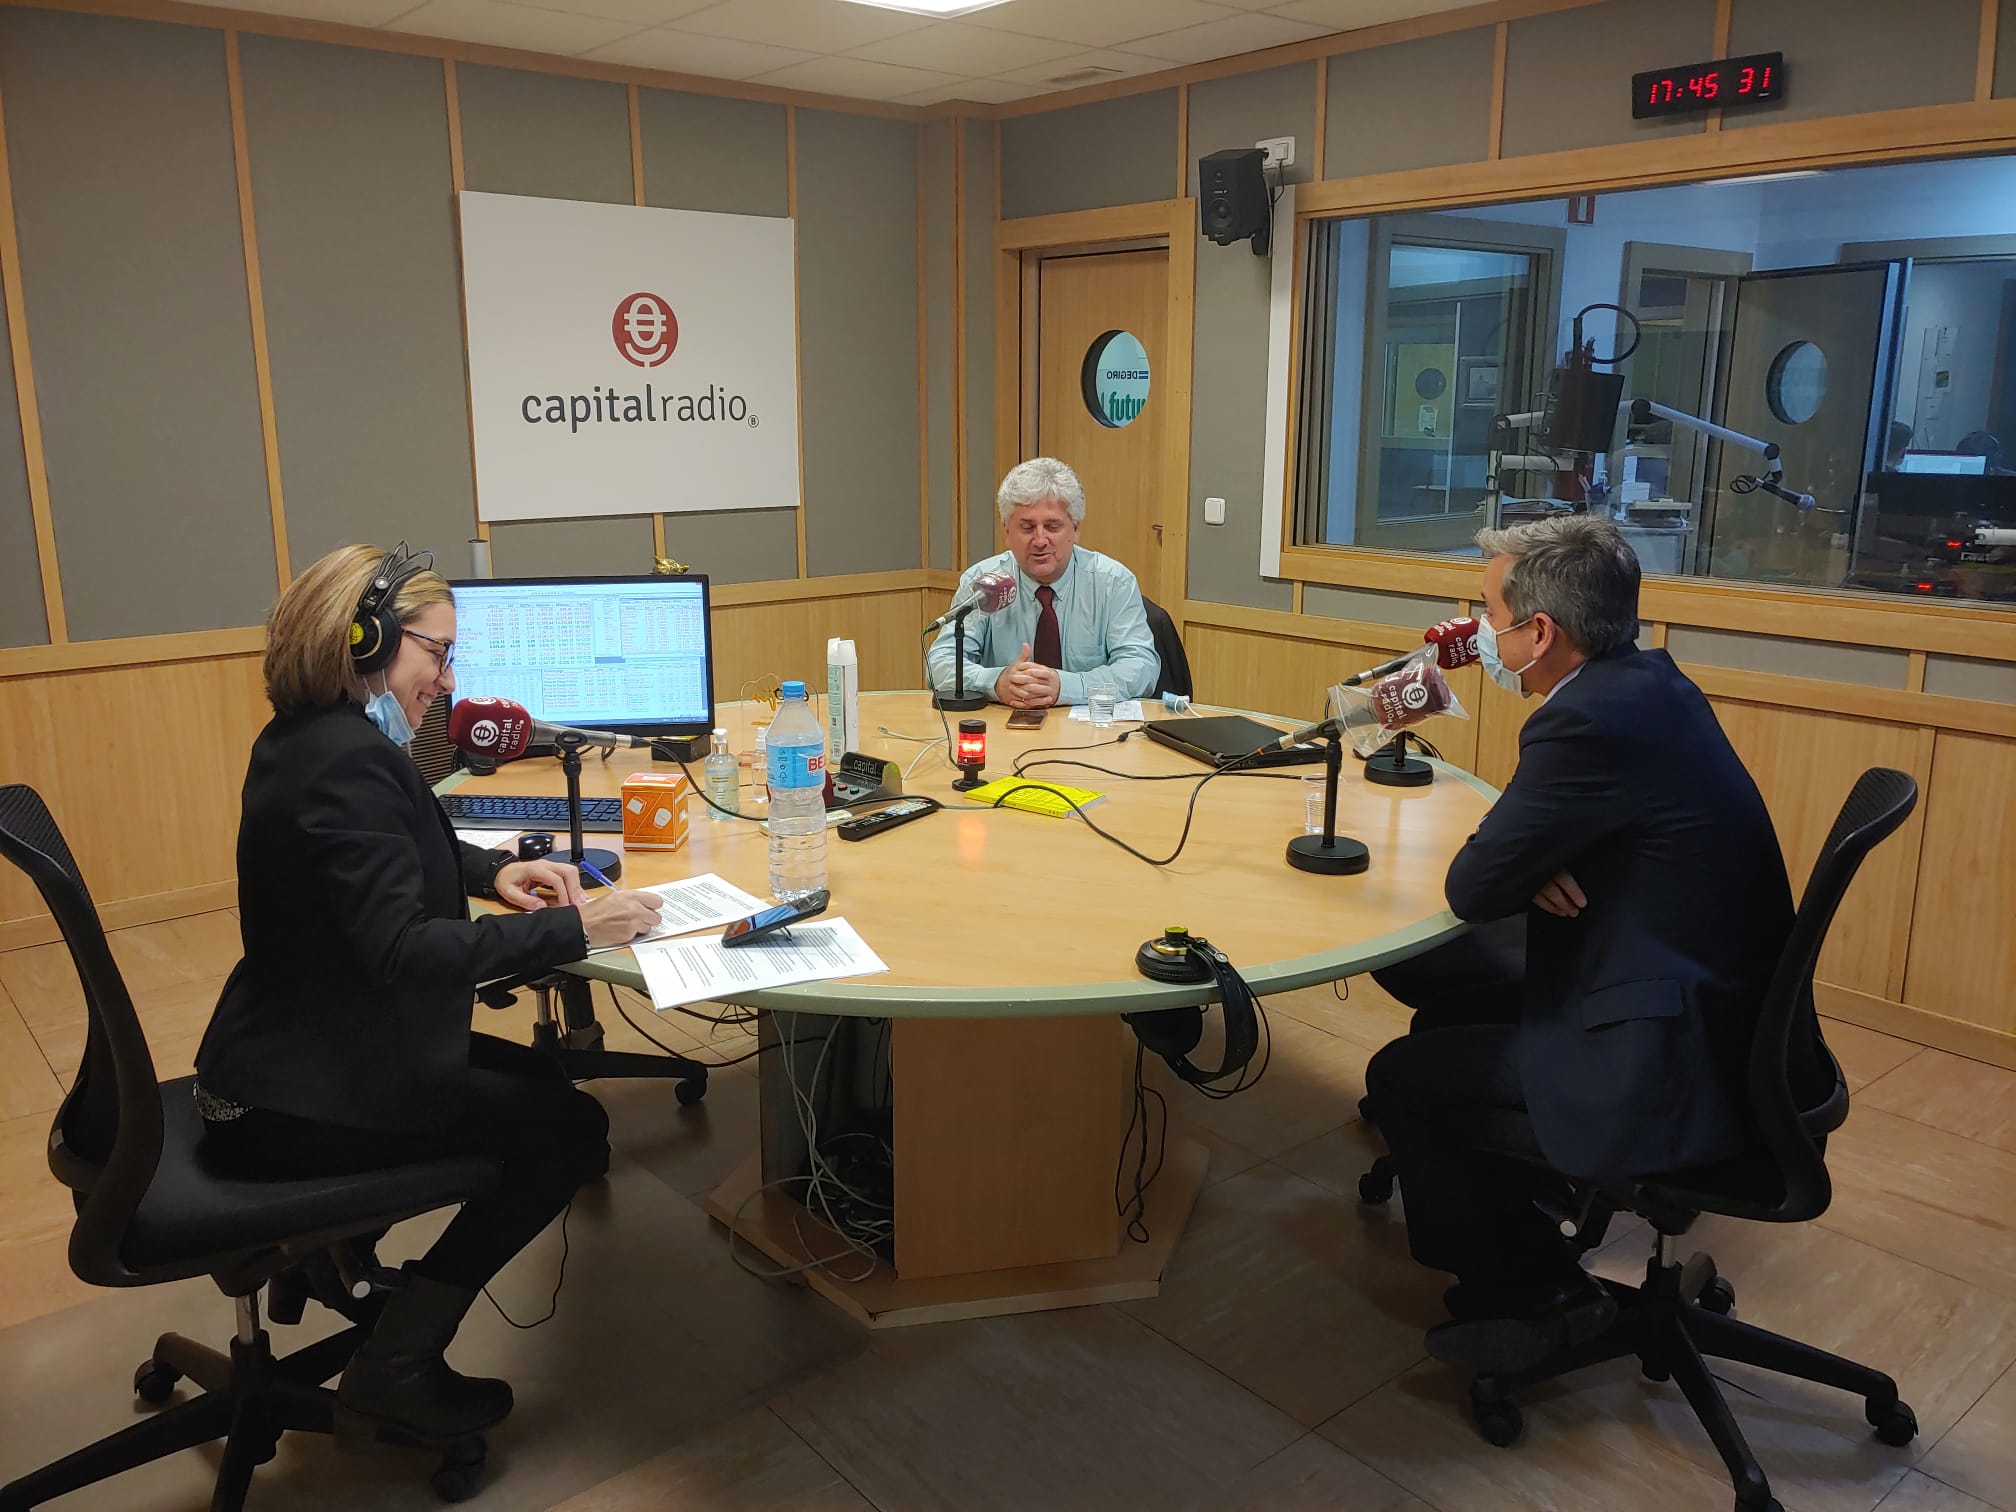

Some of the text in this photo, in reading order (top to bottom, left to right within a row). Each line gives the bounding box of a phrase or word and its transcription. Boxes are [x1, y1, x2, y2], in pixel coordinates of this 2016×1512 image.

[1649, 67, 1771, 104] 17:45 31
[1455, 636, 1468, 664] capital
[1388, 685, 1408, 720] capital
[498, 718, 513, 754] capital
[853, 759, 877, 776] capital
